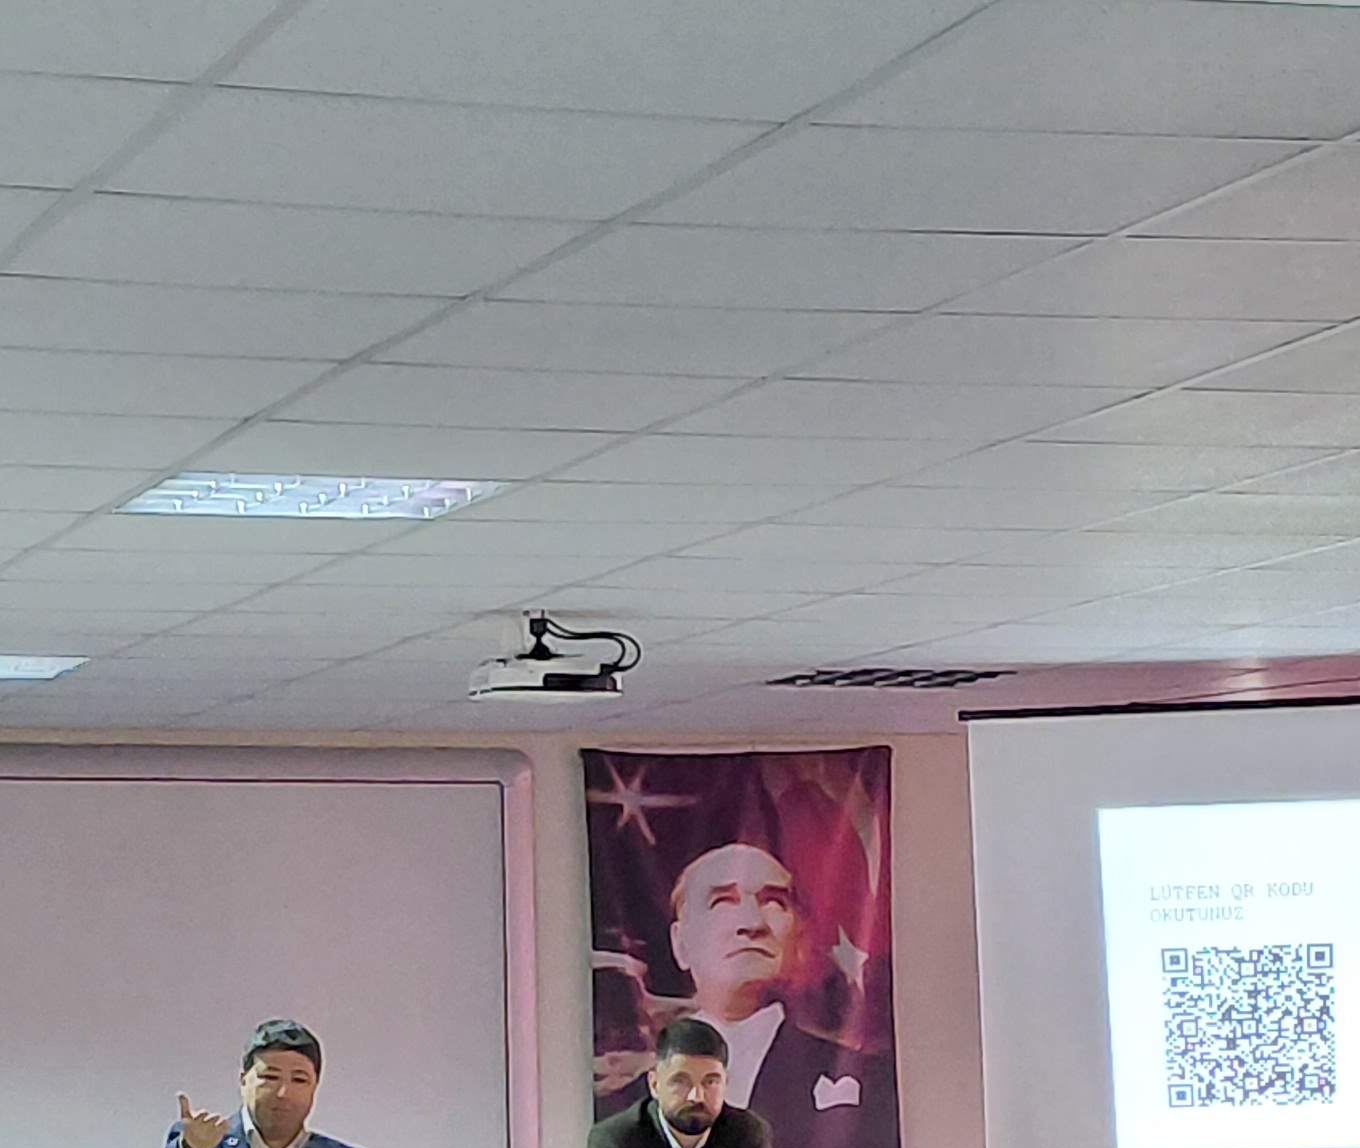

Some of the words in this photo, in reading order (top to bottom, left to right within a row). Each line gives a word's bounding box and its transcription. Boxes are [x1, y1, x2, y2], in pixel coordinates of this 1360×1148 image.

[1231, 883, 1255, 901] QR
[1267, 881, 1314, 898] KODU
[1150, 906, 1243, 922] OKUTUNUZ
